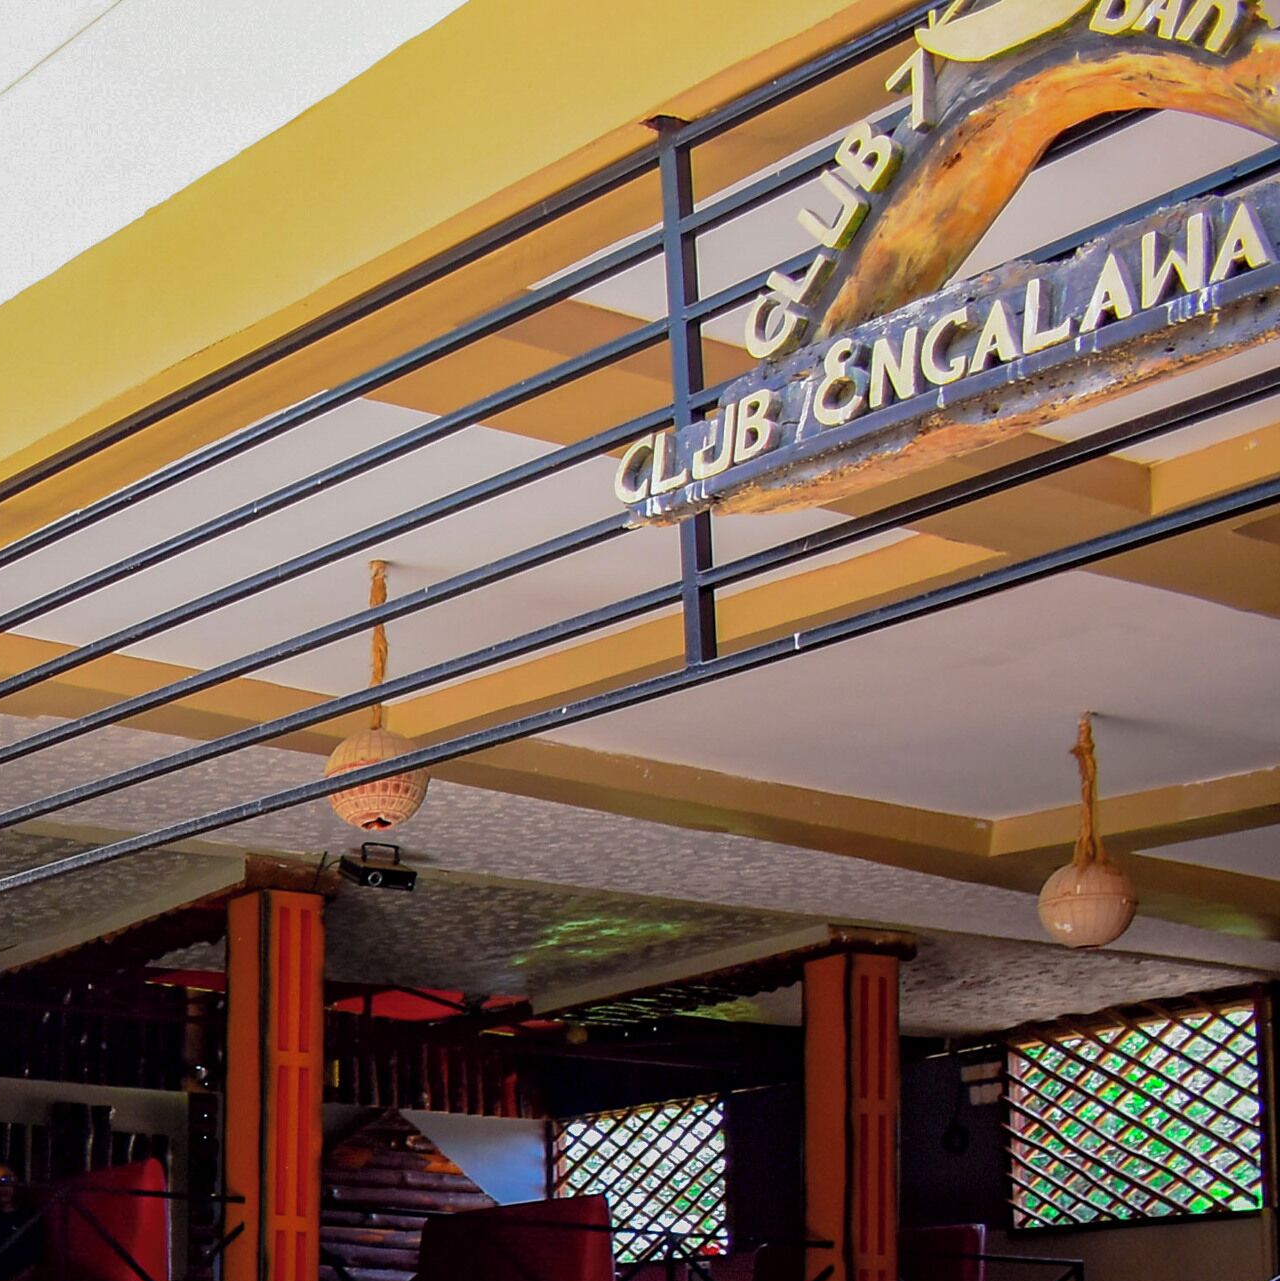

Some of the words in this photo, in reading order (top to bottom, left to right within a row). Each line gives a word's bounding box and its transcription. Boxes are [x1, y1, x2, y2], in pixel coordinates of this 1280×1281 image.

[745, 122, 894, 358] CLUB
[883, 47, 923, 130] 7
[614, 388, 779, 504] CLUB
